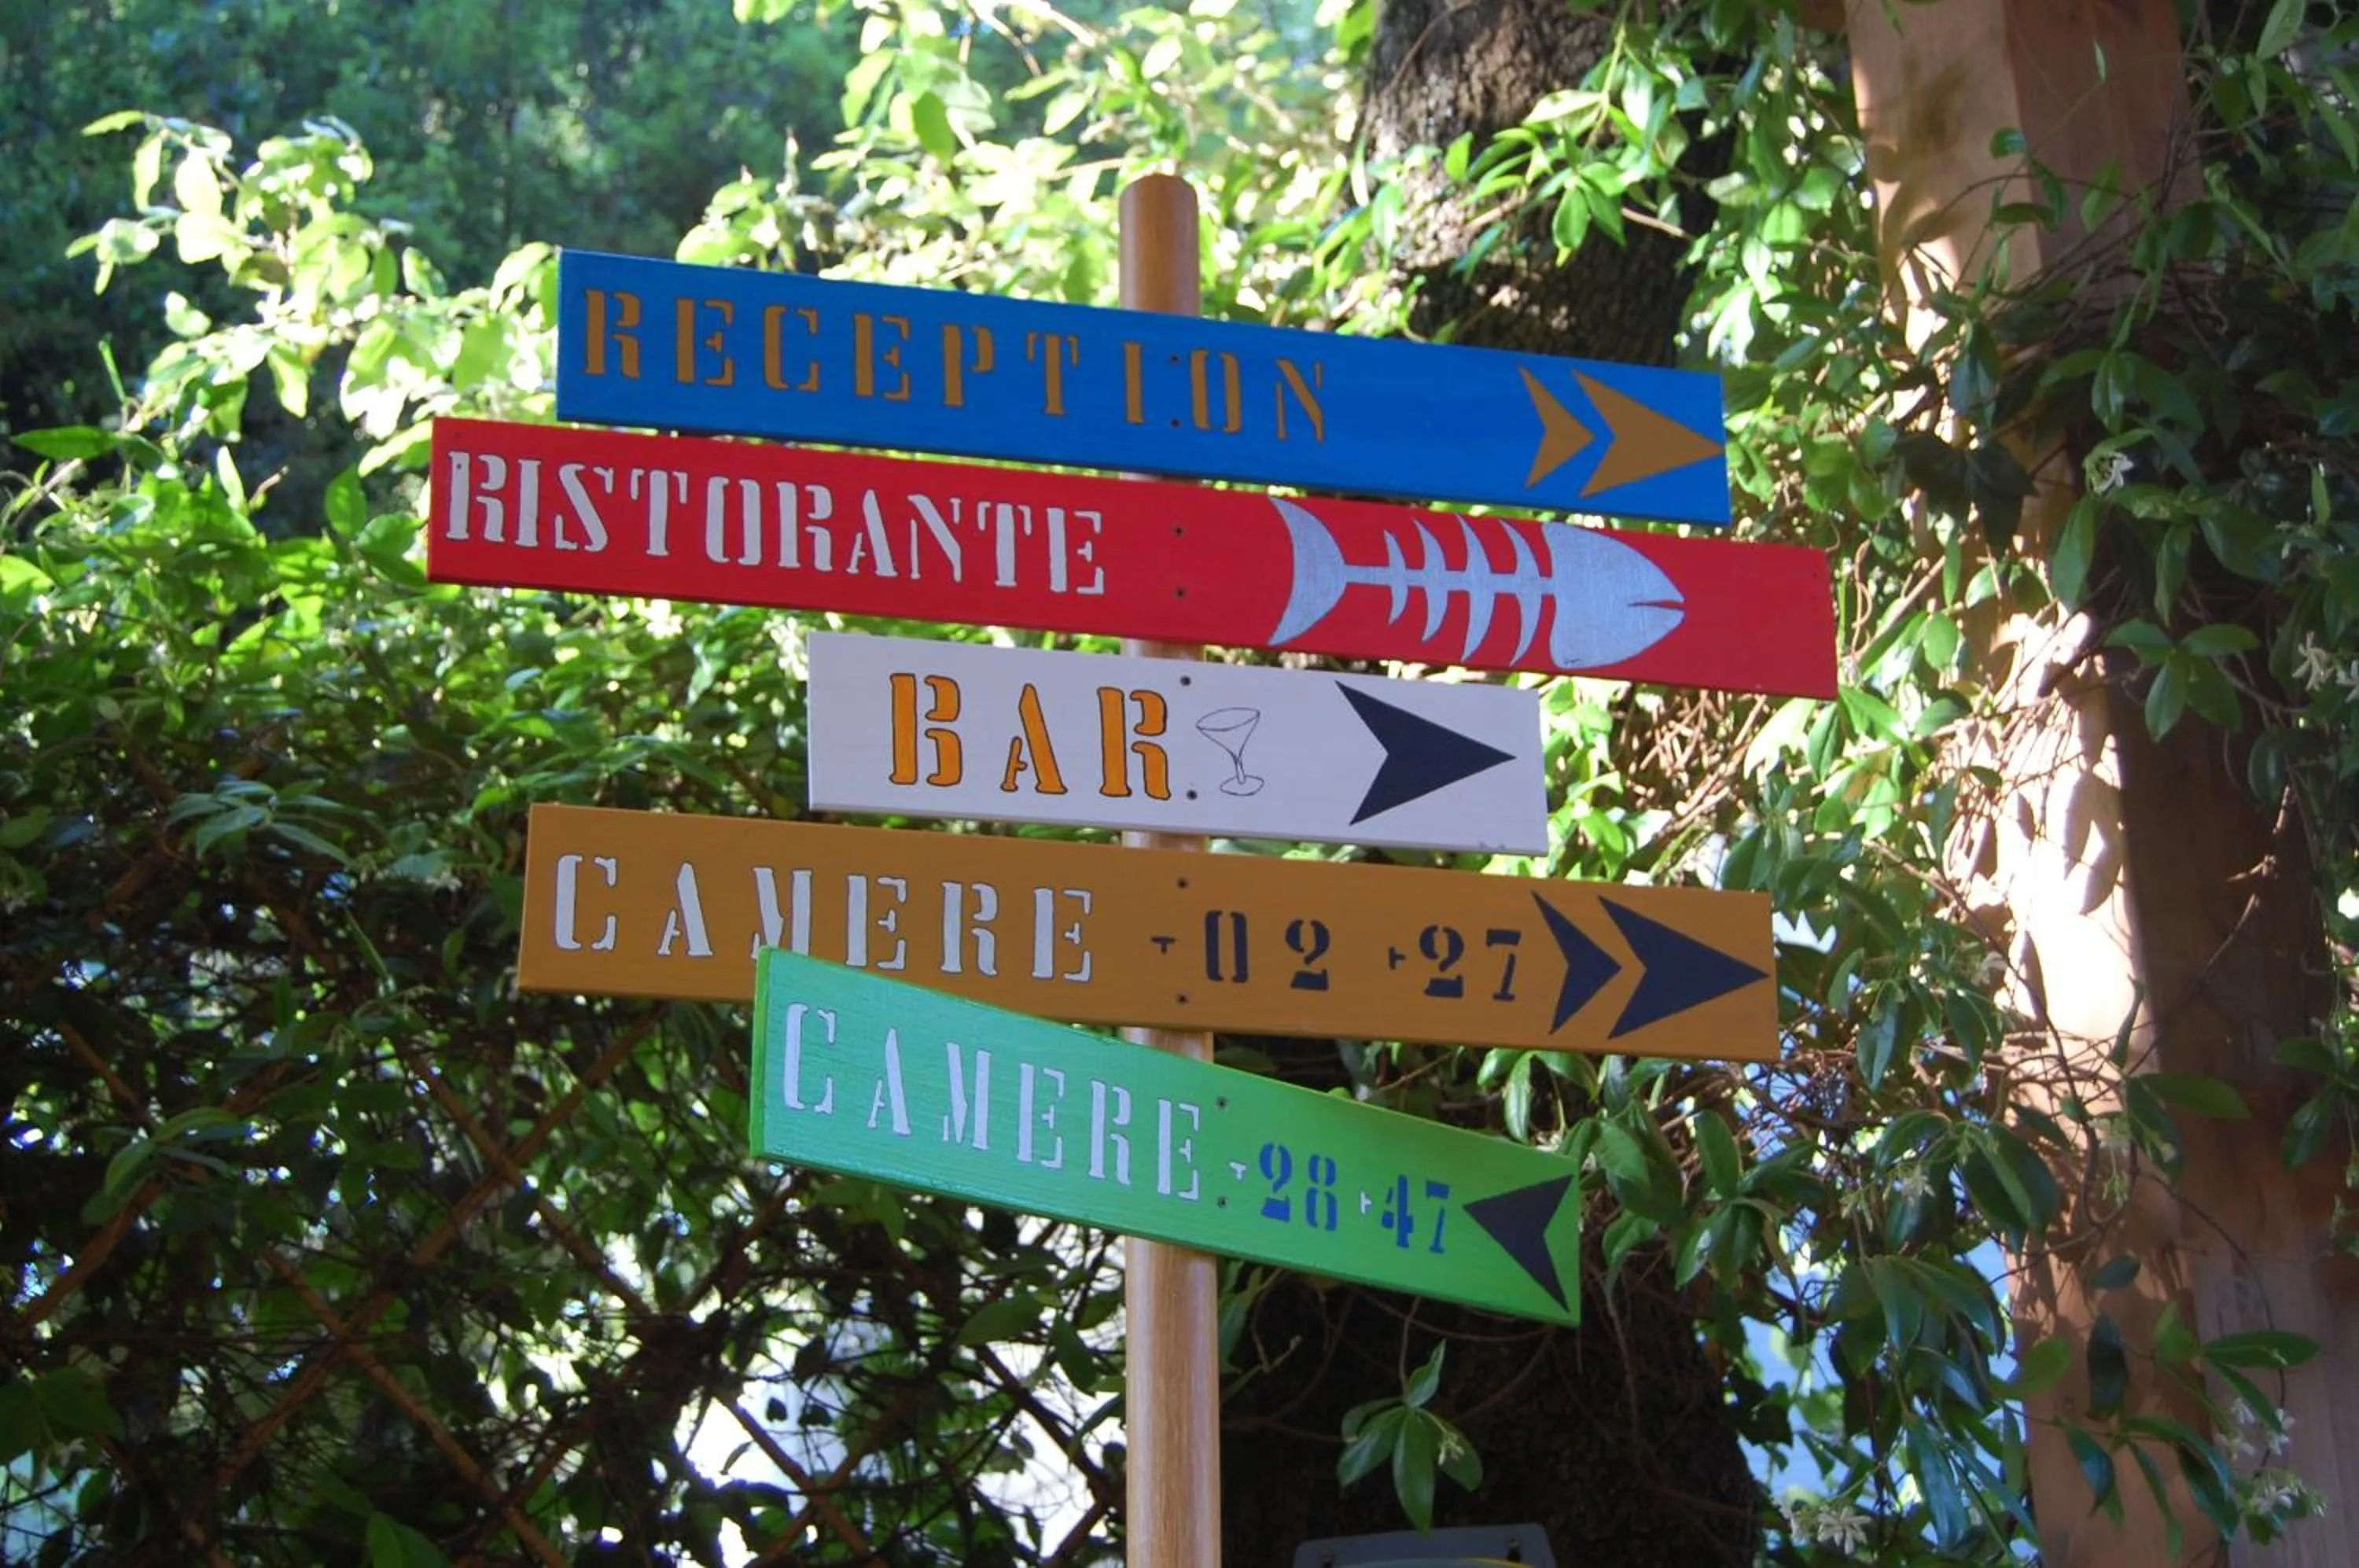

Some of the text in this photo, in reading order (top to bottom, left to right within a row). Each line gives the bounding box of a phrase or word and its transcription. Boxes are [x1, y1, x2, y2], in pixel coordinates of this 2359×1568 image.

[584, 289, 1324, 442] RECEPTION
[443, 450, 1105, 595] RISTORANTE
[889, 672, 1170, 801] BAR
[554, 854, 1091, 982] CAMERE
[783, 1003, 1199, 1201] CAMERE
